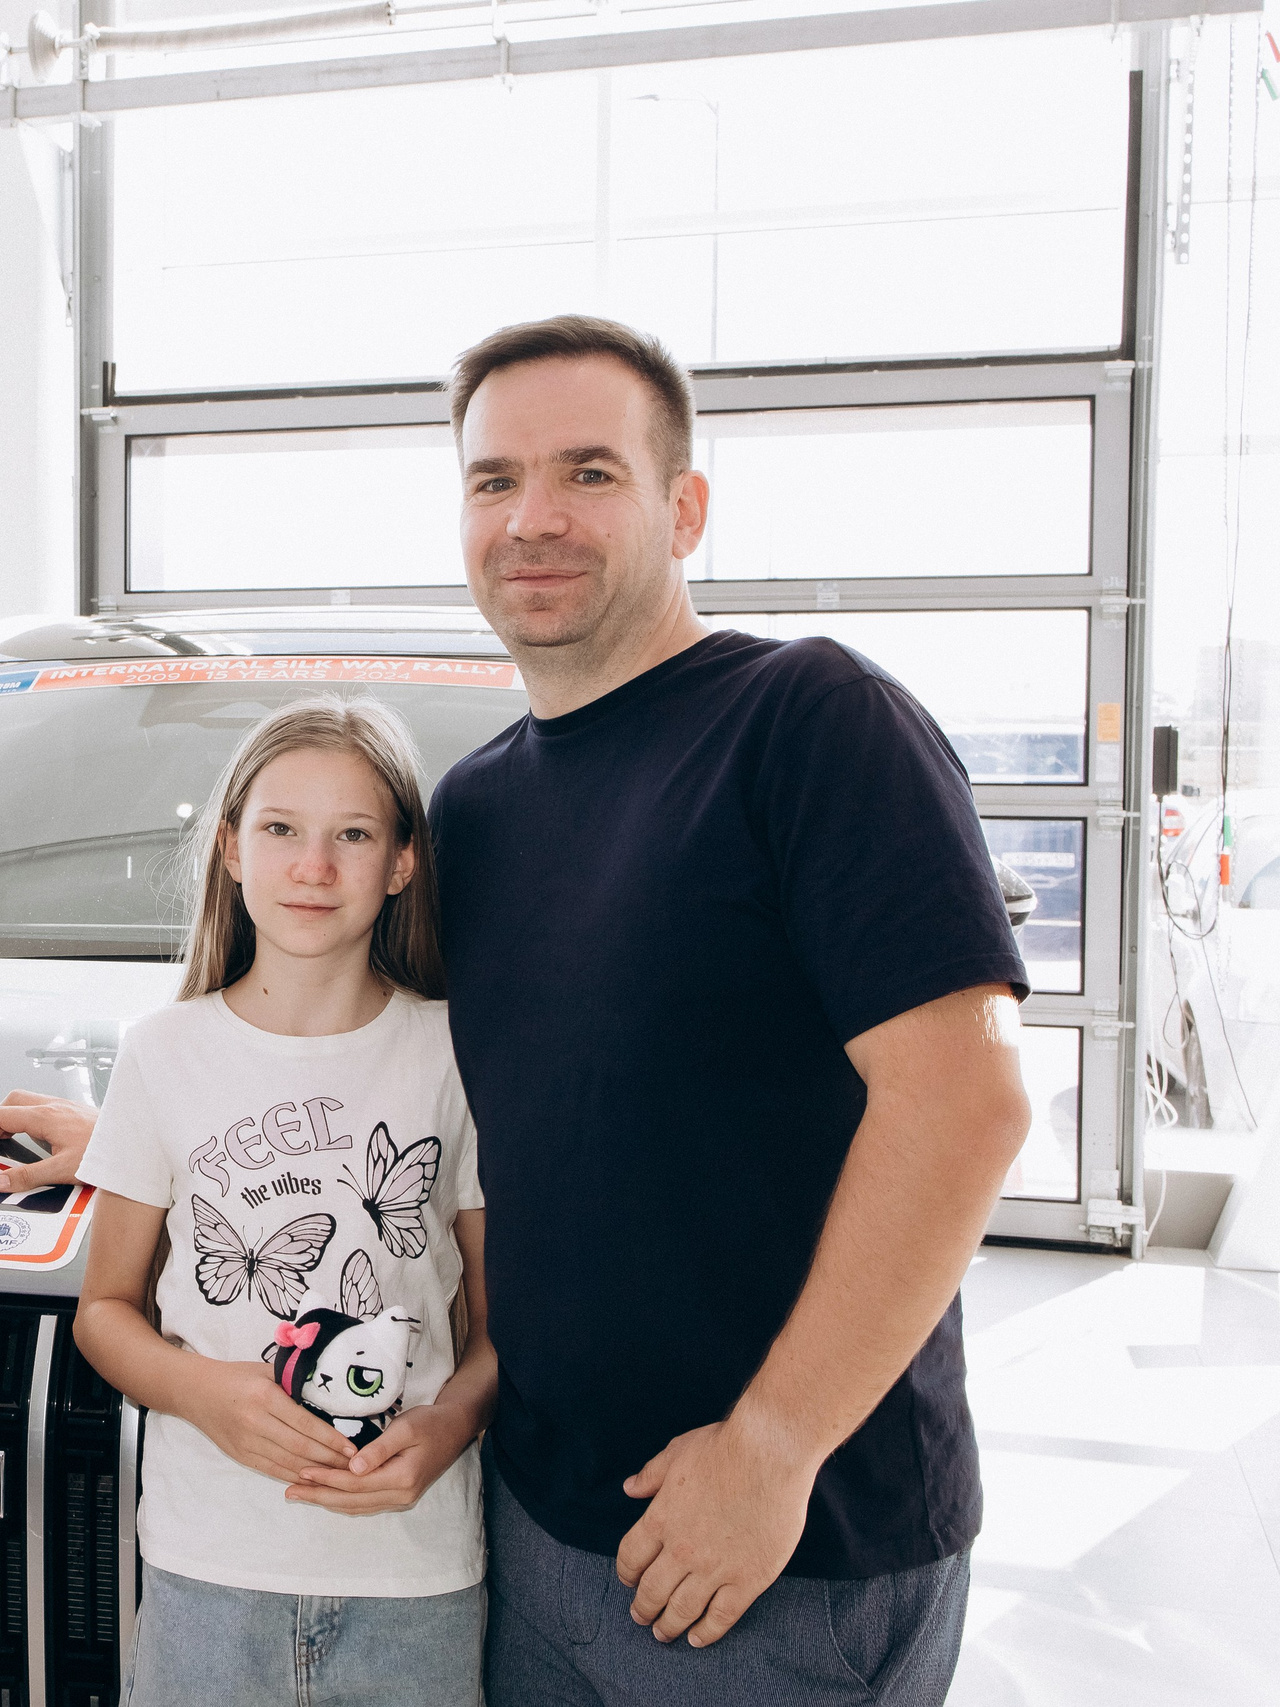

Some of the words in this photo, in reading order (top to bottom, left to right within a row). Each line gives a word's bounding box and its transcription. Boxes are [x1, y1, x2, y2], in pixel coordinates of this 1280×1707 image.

[48, 659, 258, 680] INTERNATIONAL
[270, 659, 334, 669] SILK
[341, 660, 406, 671] WAY
[413, 662, 504, 675] RALLY
[123, 672, 181, 683] 2009
[205, 670, 228, 680] 15
[239, 669, 326, 680] YEARS
[354, 670, 410, 680] 2024
[188, 1096, 353, 1198] FEEL
[240, 1181, 271, 1209] the
[271, 1172, 322, 1198] vibes
